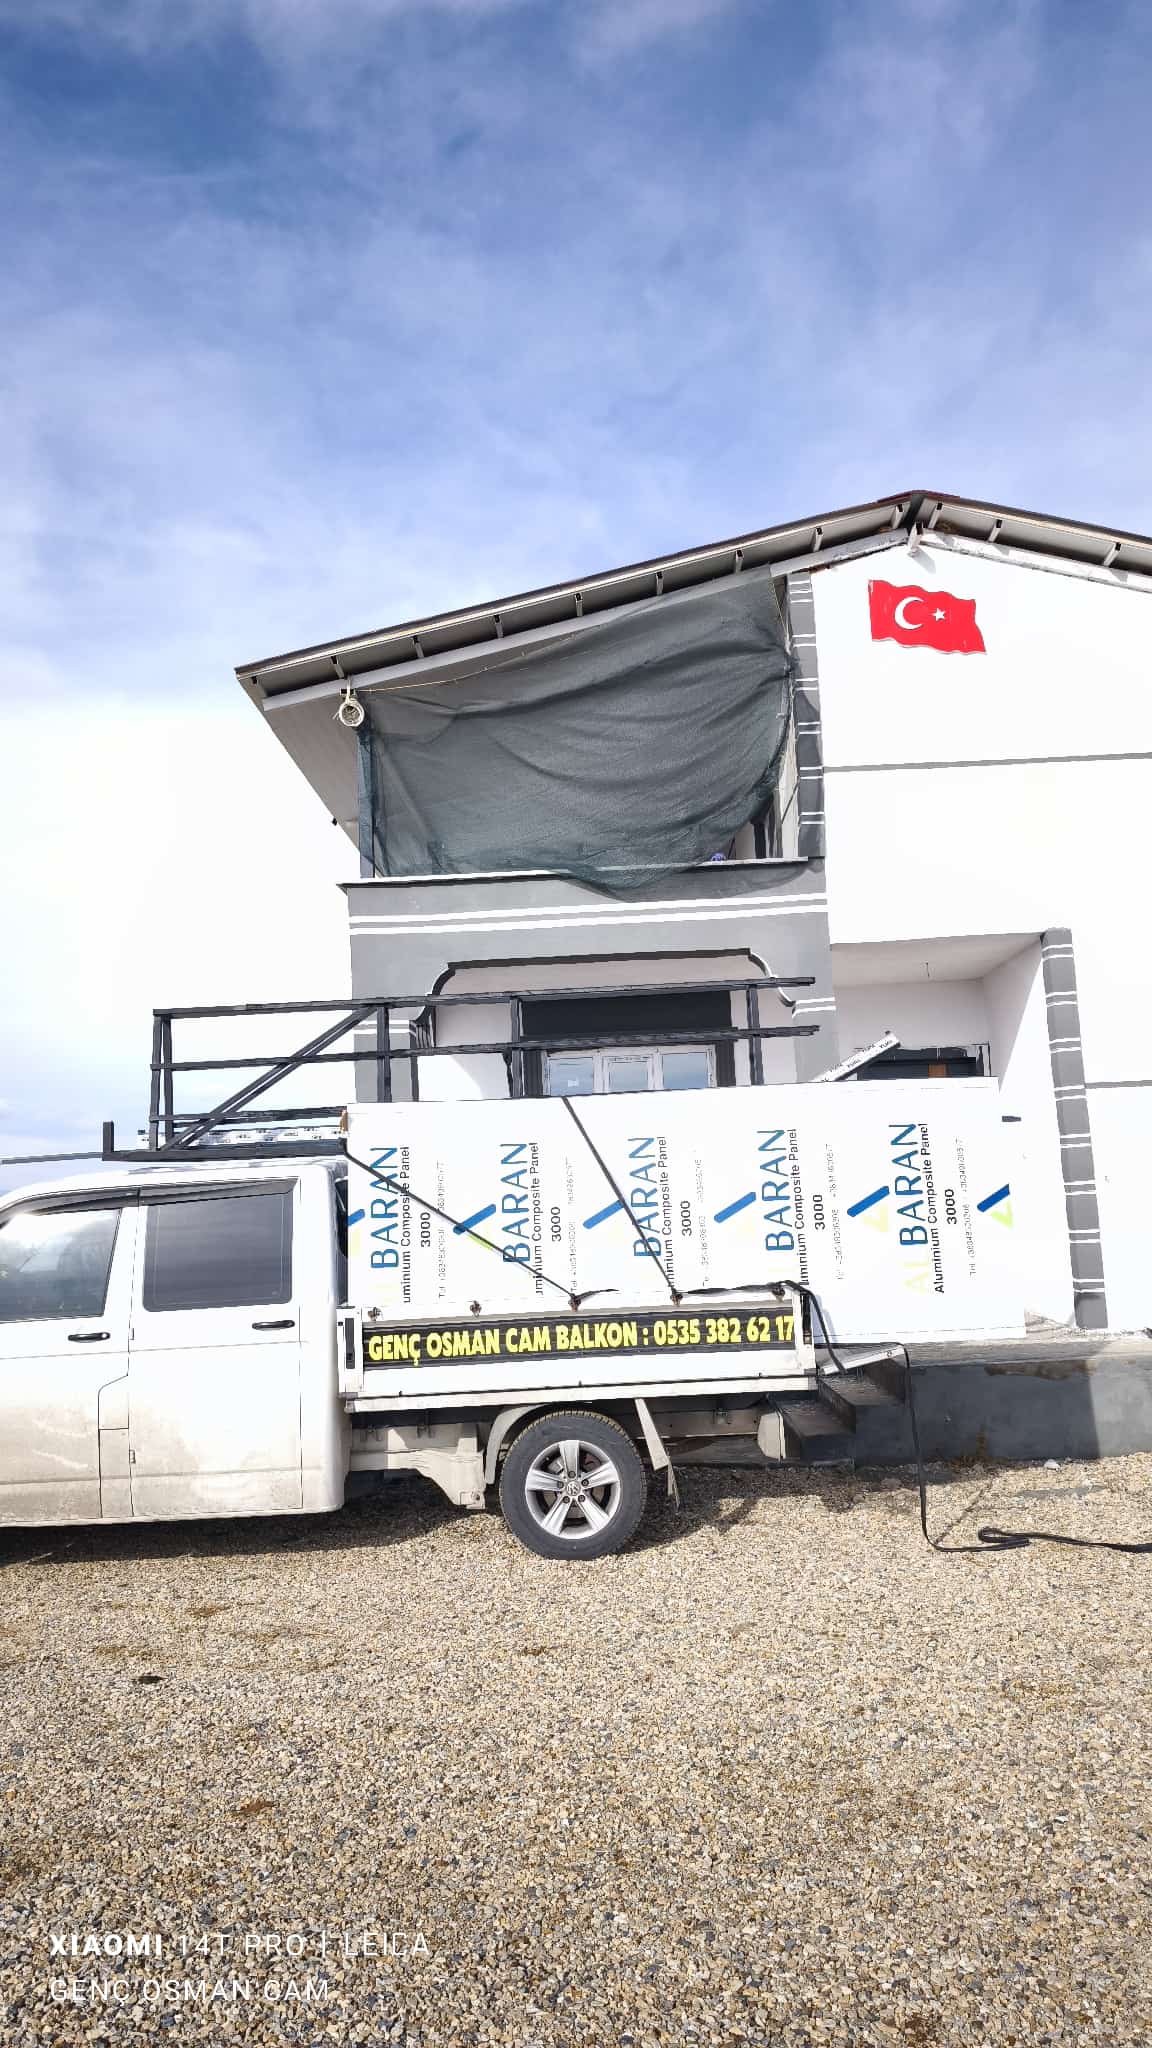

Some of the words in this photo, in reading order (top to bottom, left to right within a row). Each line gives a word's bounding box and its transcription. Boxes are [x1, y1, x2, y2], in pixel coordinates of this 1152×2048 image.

[399, 1146, 410, 1179] Panel
[528, 1142, 539, 1174] Panel
[656, 1136, 668, 1168] Panel
[786, 1128, 799, 1161] Panel
[918, 1123, 930, 1155] Panel
[369, 1146, 399, 1269] BARAN
[400, 1183, 413, 1246] Composite
[499, 1143, 531, 1263] BARAN
[529, 1178, 543, 1242] Composite
[627, 1136, 662, 1257] BARAN
[660, 1172, 673, 1236] Composite
[756, 1129, 794, 1252] BARAN
[790, 1164, 806, 1230] Composite
[812, 1194, 825, 1230] 3000
[922, 1160, 937, 1224] Composite
[944, 1188, 957, 1225] 3000
[420, 1211, 431, 1248] 3000
[550, 1206, 561, 1242] 3000
[679, 1200, 692, 1237] 3000
[400, 1251, 411, 1304] uminium
[930, 1228, 945, 1293] Aluminium
[368, 1333, 421, 1366] GENÇ
[426, 1329, 500, 1357] OSMAN
[506, 1325, 551, 1352] CAM
[556, 1321, 637, 1349] BALKON
[654, 1319, 700, 1345] 0535
[705, 1317, 741, 1343] 382
[747, 1316, 770, 1342] 62
[775, 1315, 794, 1341] 17
